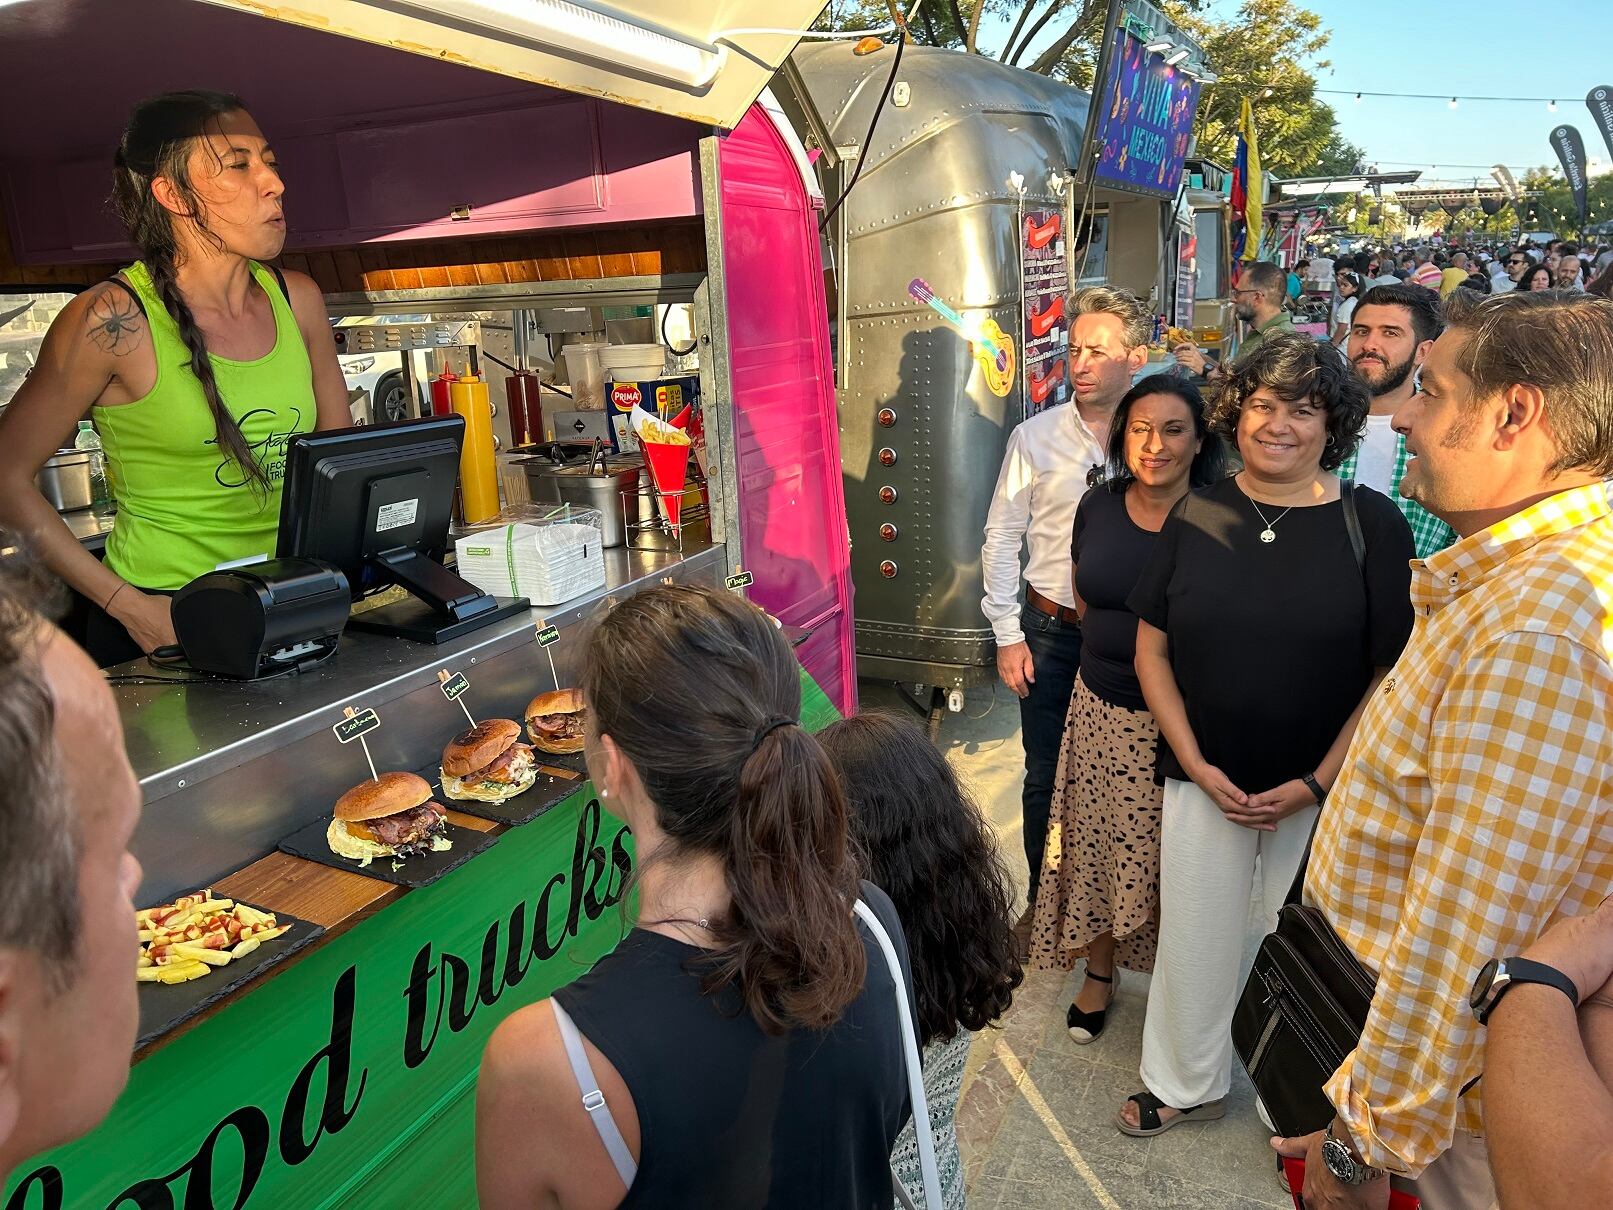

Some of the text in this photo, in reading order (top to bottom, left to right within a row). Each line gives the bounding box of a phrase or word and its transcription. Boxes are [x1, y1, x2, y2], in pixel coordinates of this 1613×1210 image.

[1141, 70, 1173, 130] VIVA
[1127, 124, 1165, 165] MEXICO
[614, 391, 639, 401] PRIMA
[728, 575, 748, 588] Magic
[403, 799, 632, 1069] trucks
